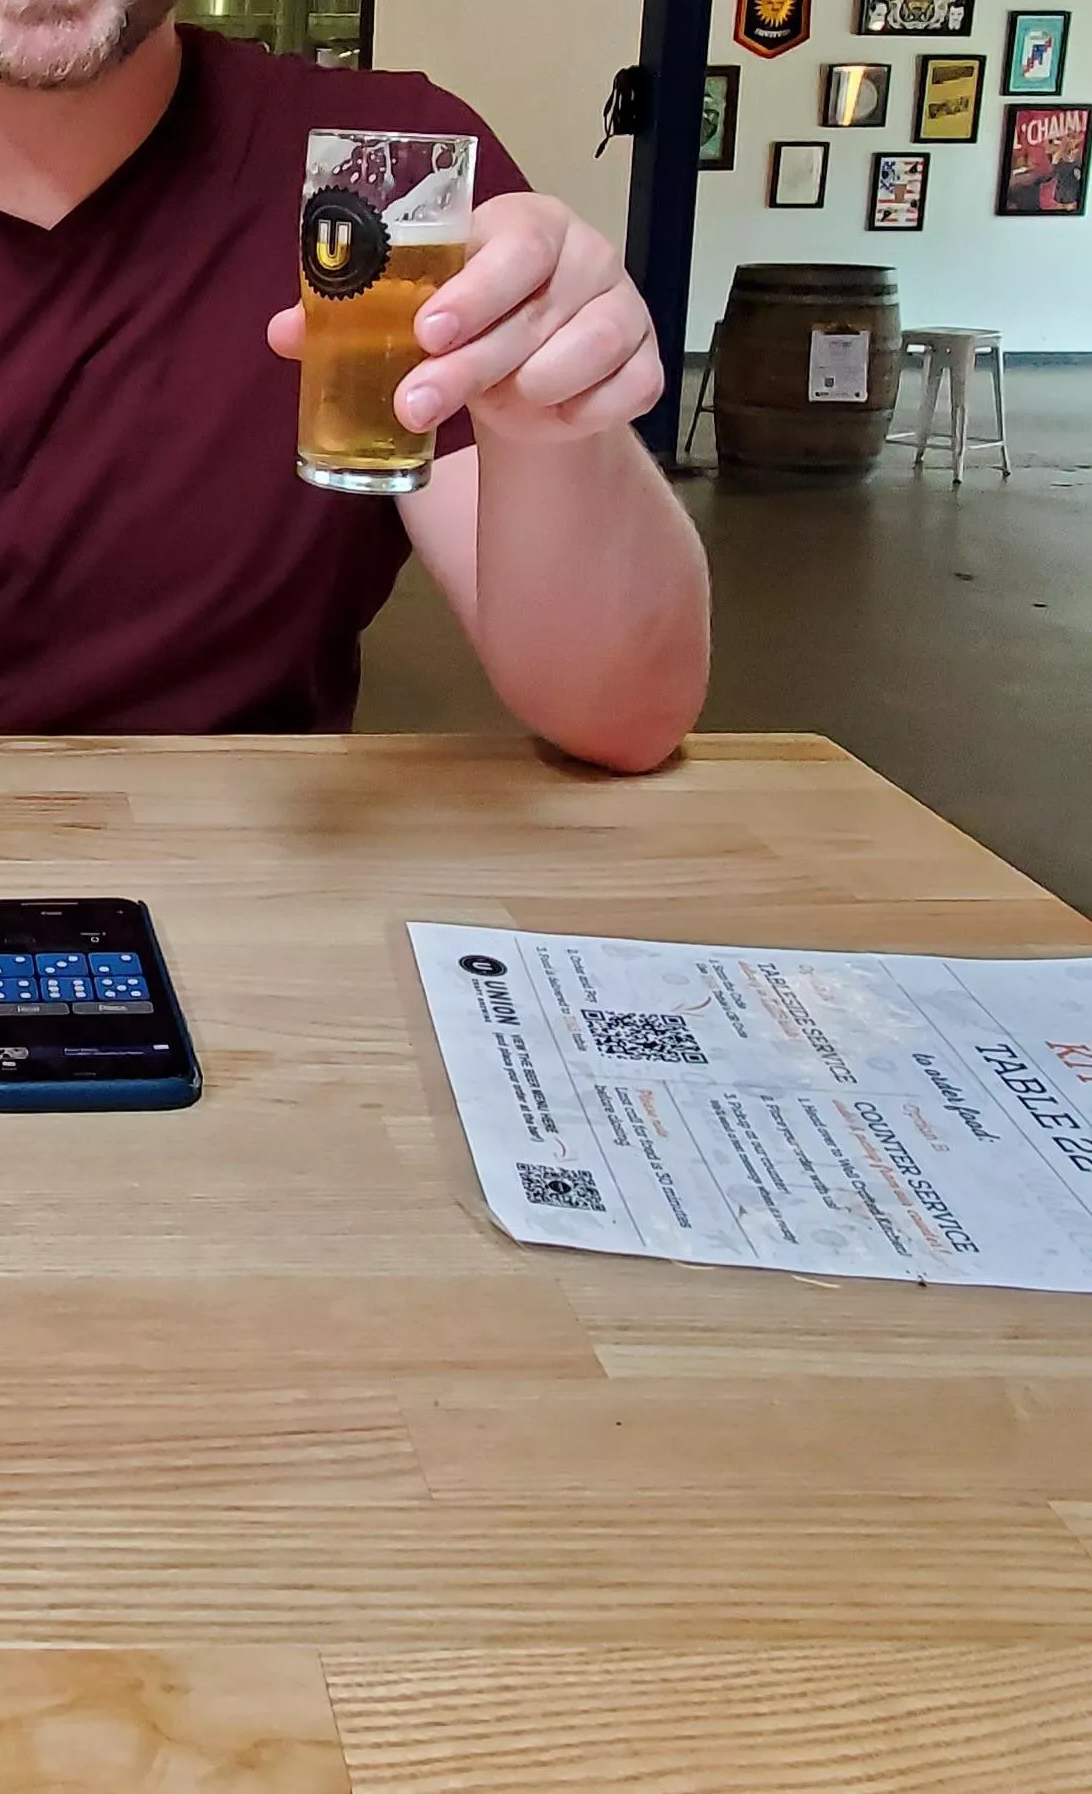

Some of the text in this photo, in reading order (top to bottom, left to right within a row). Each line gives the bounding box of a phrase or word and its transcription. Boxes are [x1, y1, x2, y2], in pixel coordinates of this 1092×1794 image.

[316, 219, 351, 271] U
[470, 960, 493, 970] U
[483, 980, 520, 1026] UNION
[757, 962, 816, 1026] TABLESIDE
[801, 1027, 857, 1084] SERVICE
[510, 1033, 559, 1134] VIEW THE BEER MENU HERE
[613, 1086, 633, 1106] Last
[911, 1053, 1000, 1143] to order food:
[974, 1043, 1081, 1129] TABLE
[593, 1084, 631, 1147] before closing
[623, 1106, 644, 1124] call
[631, 1124, 648, 1138] for
[638, 1139, 661, 1160] food
[654, 1171, 674, 1186] 30
[854, 1101, 979, 1253] COUNTER SERVICE
[661, 1186, 692, 1229] minutes
